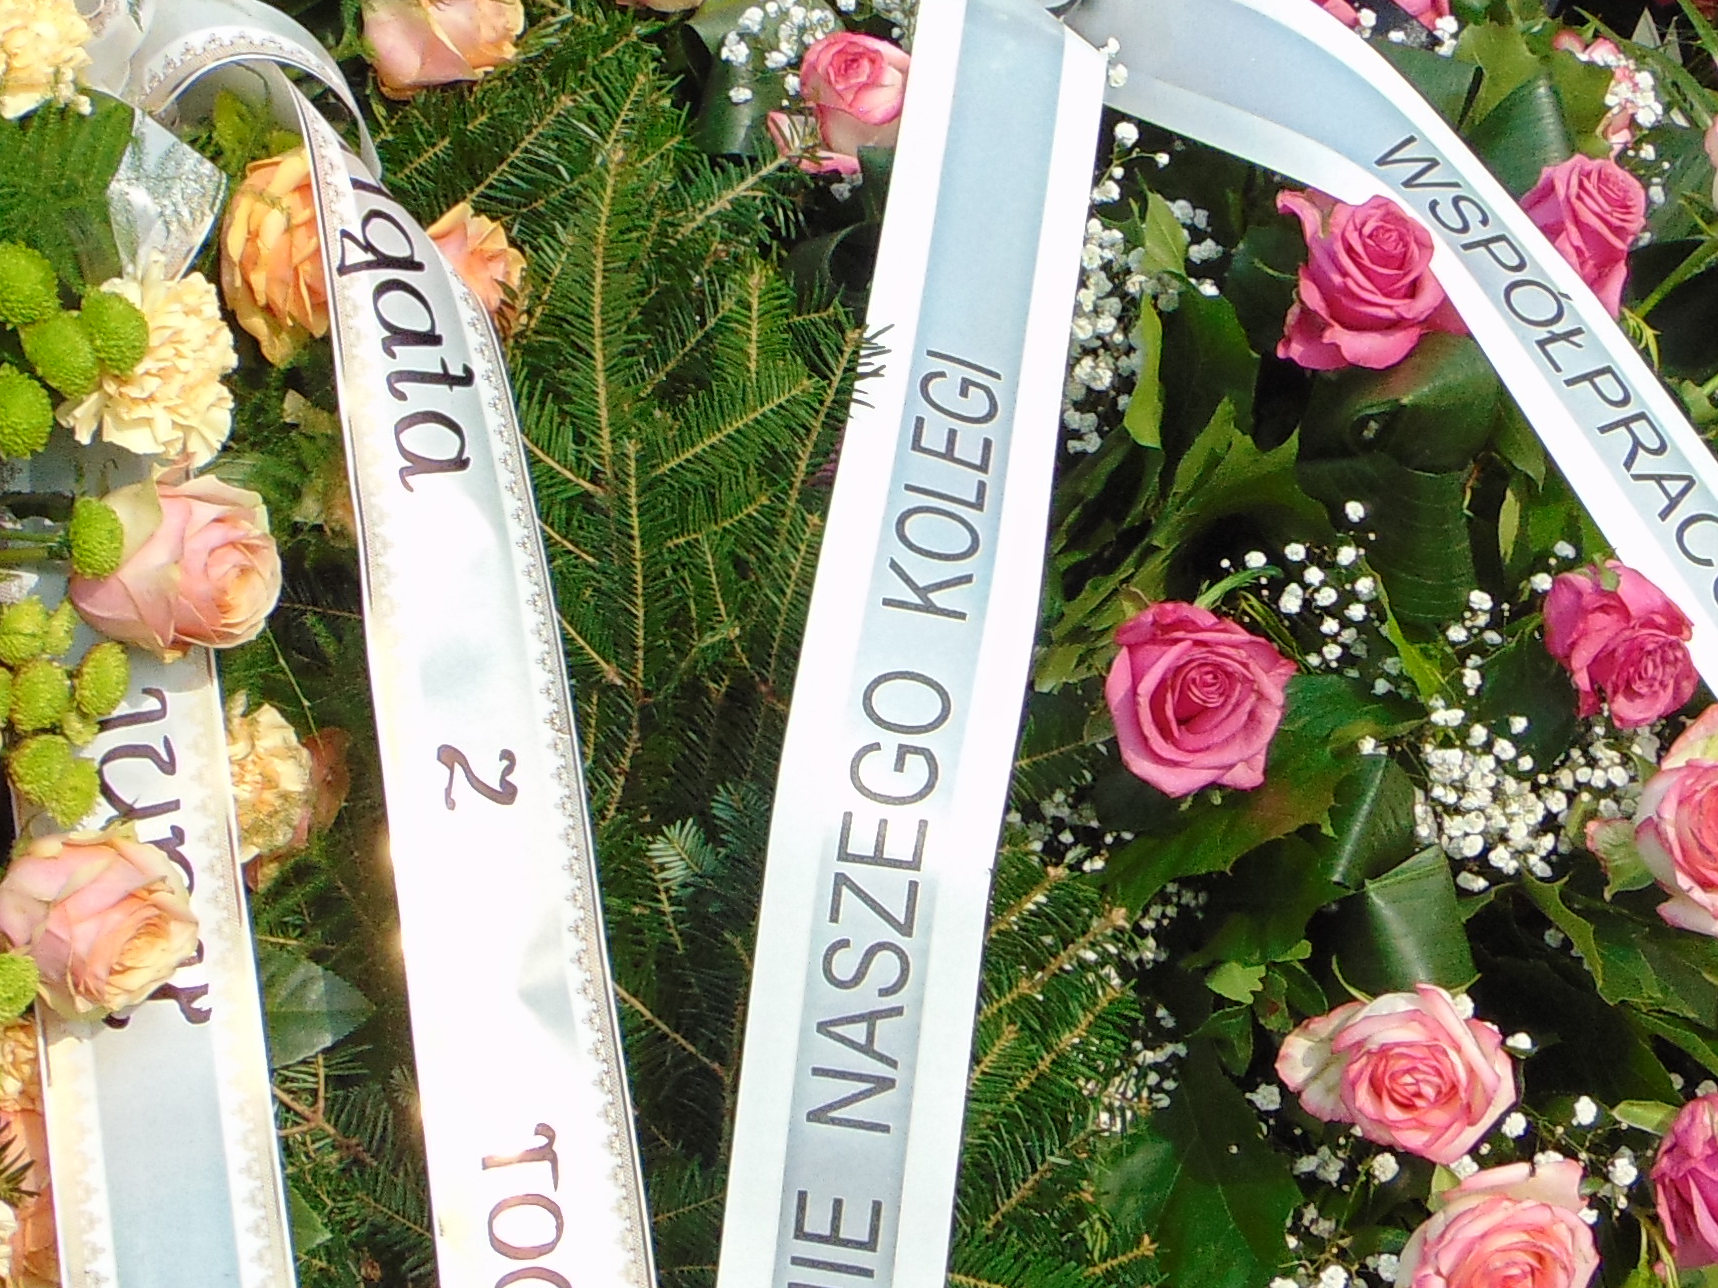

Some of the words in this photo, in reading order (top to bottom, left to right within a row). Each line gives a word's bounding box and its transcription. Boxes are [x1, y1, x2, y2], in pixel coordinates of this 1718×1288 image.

[336, 176, 476, 494] gata
[804, 669, 953, 1135] NASZEGO
[880, 348, 1003, 622] KOLEGI
